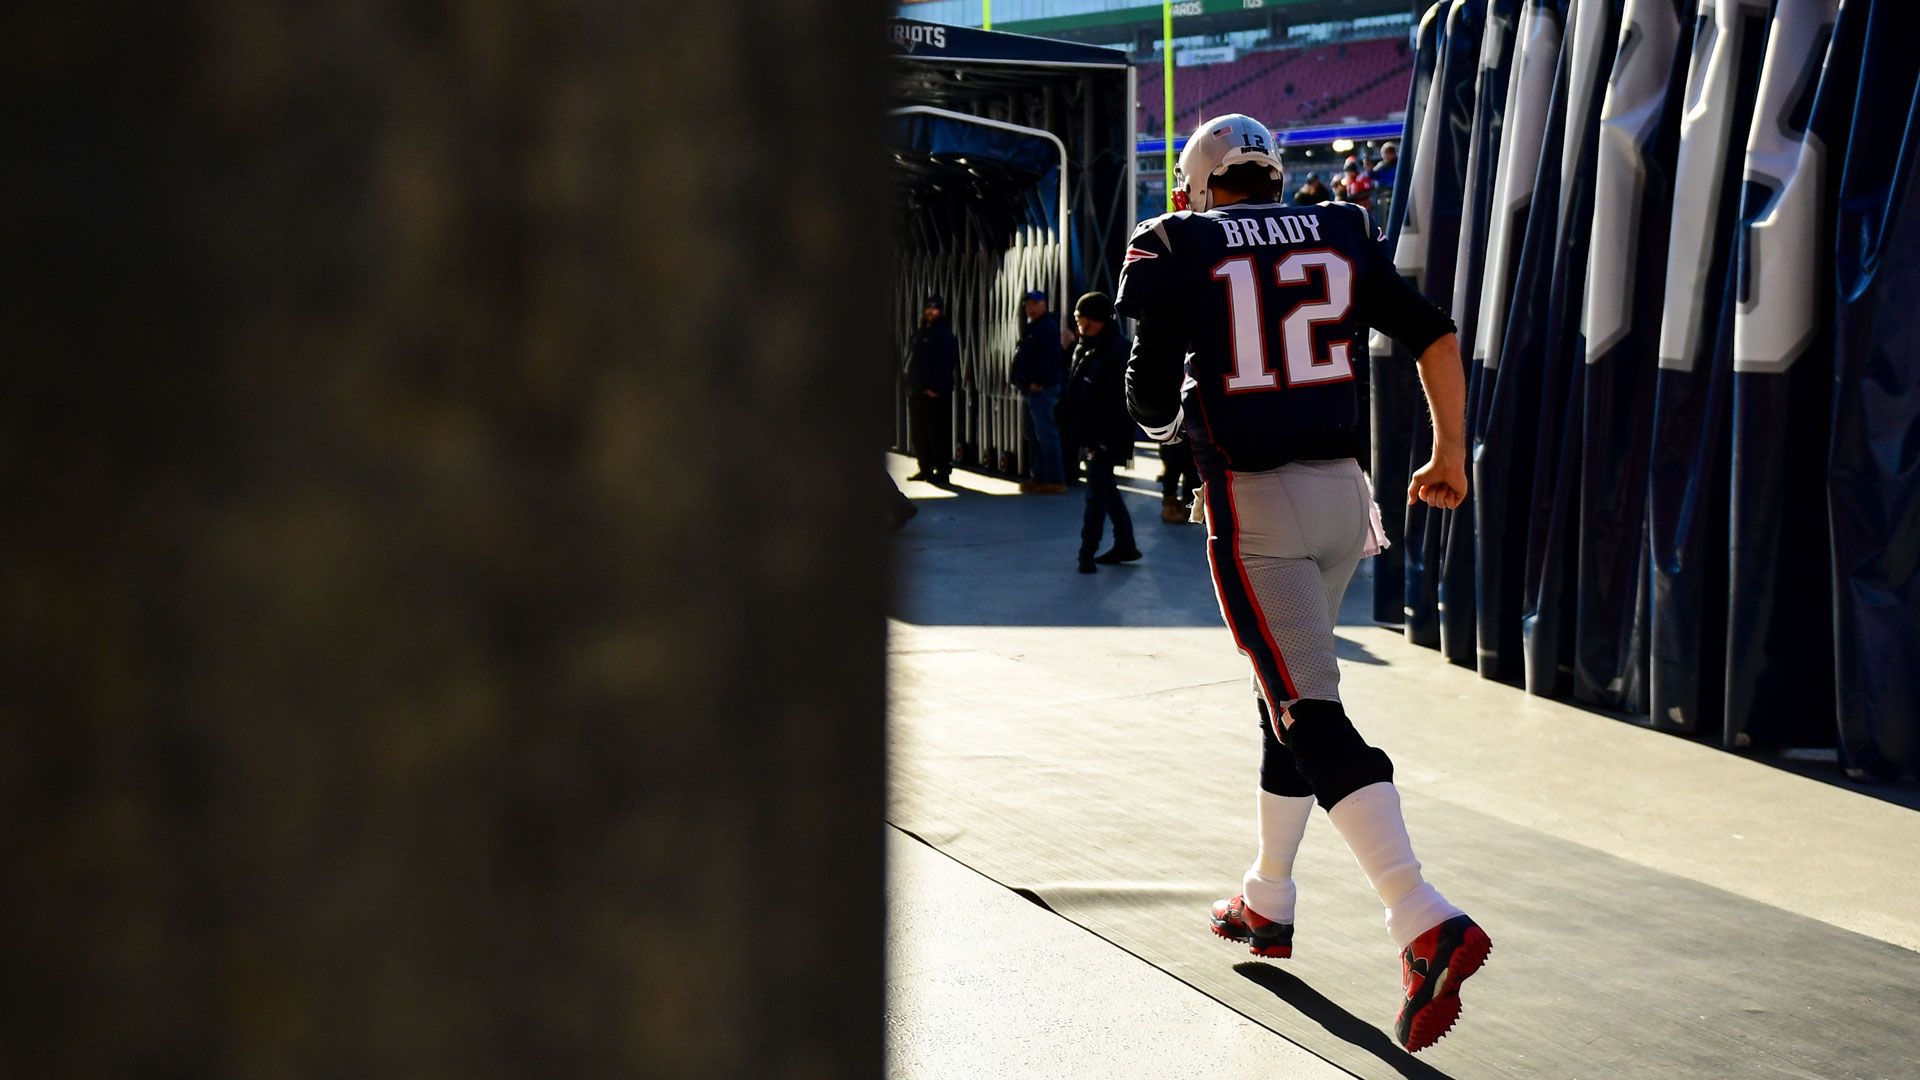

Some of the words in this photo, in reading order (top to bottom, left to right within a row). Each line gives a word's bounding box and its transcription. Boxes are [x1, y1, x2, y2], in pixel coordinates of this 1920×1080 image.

[893, 24, 945, 48] RIOTS
[1242, 133, 1265, 148] 12
[1218, 214, 1320, 247] BRADY
[1212, 249, 1354, 394] 12
